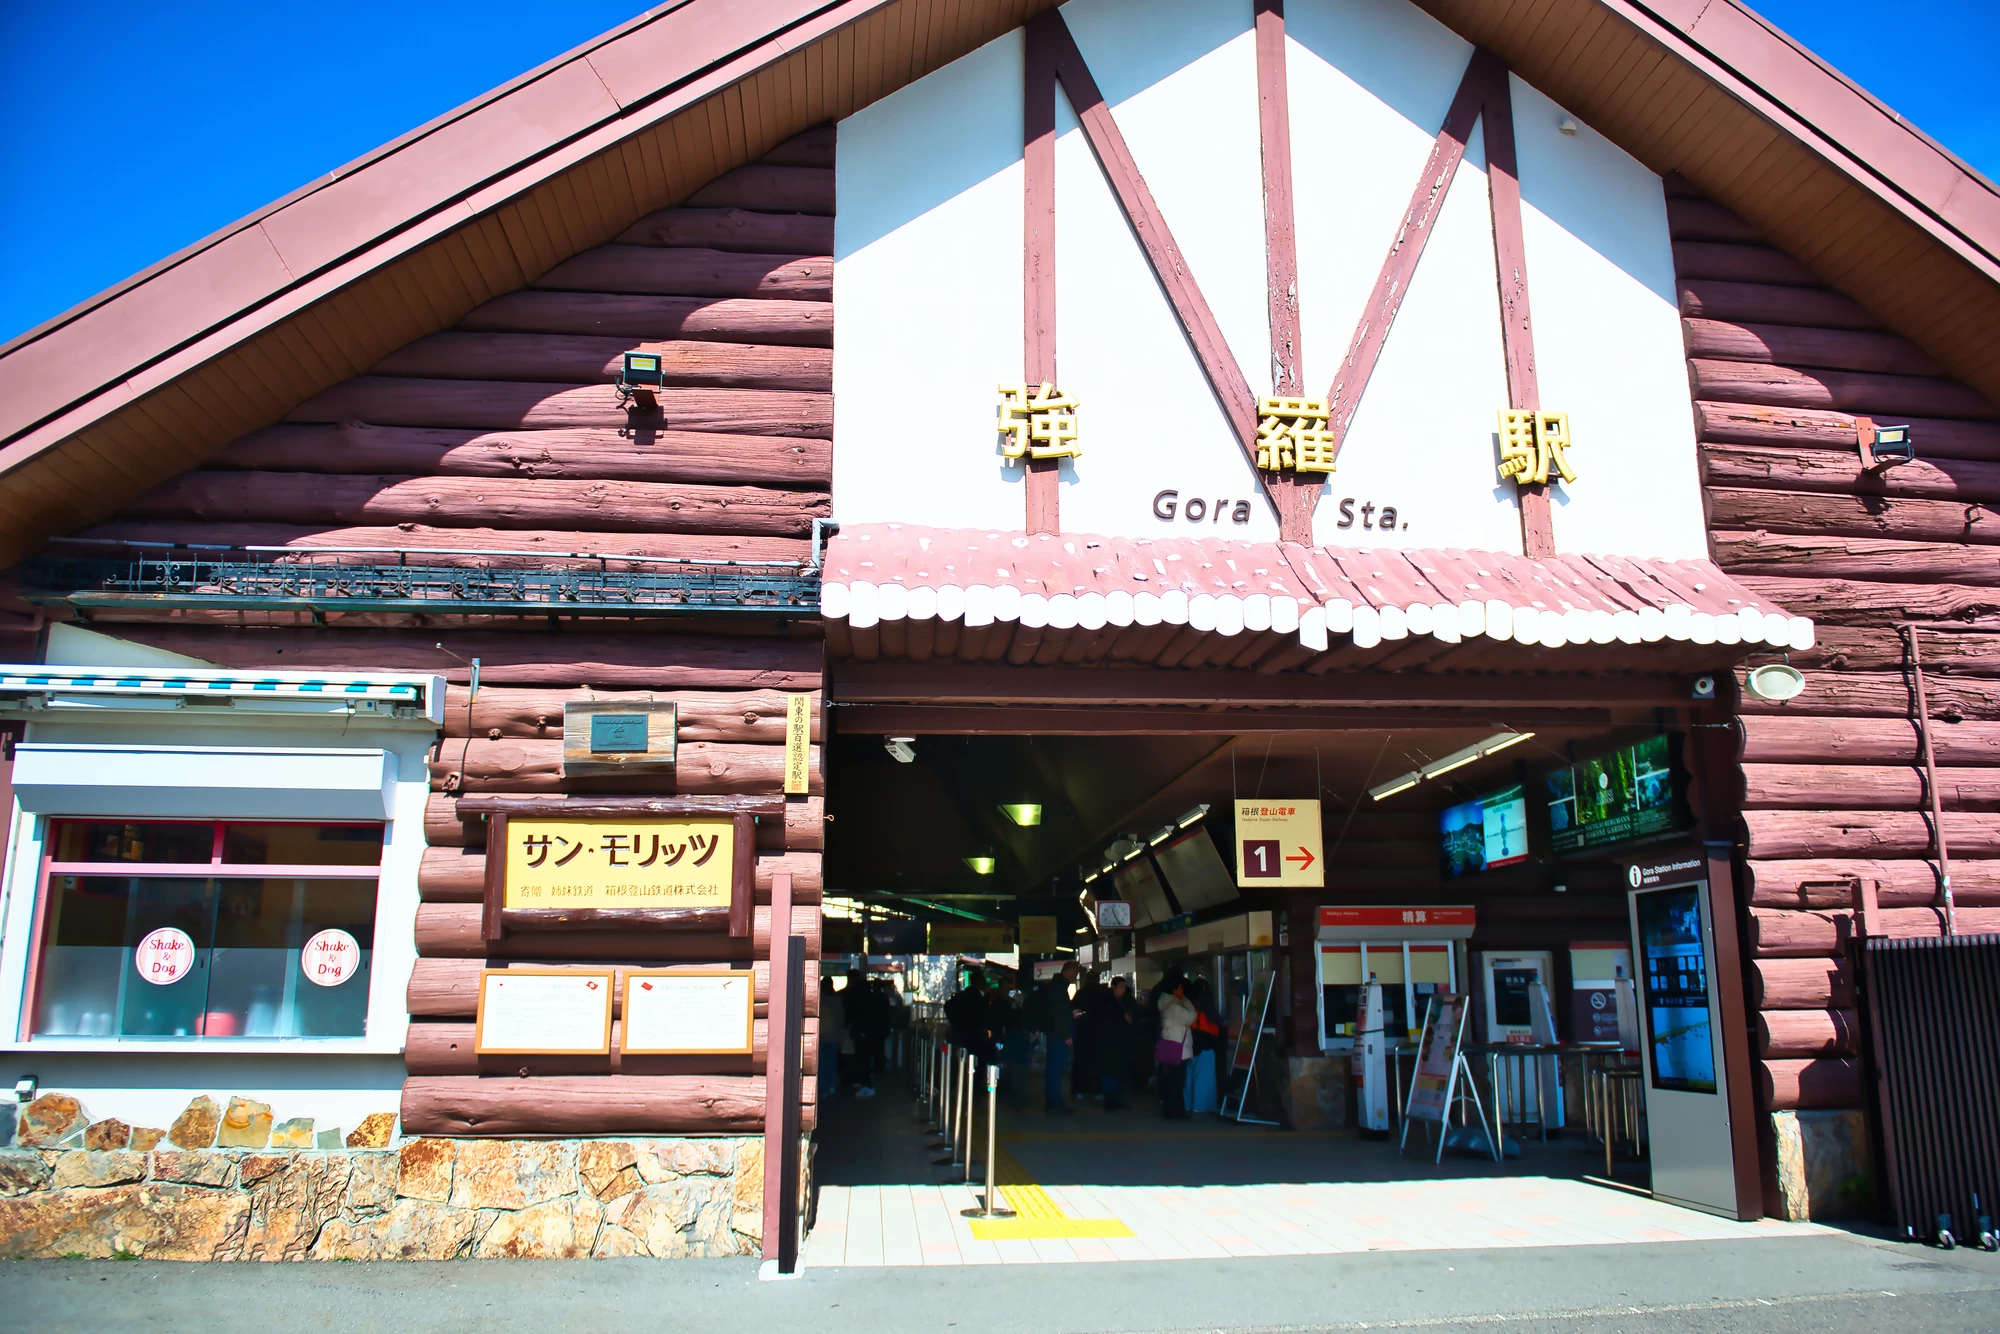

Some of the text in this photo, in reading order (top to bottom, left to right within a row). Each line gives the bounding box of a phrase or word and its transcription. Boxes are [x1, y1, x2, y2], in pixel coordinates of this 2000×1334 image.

[1152, 489, 1409, 530] Gora Sta.
[791, 696, 805, 780] 関東の駅百選認定駅
[1241, 807, 1296, 816] 箱根登山電車
[523, 834, 719, 868] サン・モリッツ
[1253, 846, 1267, 872] 1
[1642, 859, 1701, 876] Gora Station Information
[551, 885, 594, 897] 姉妹鉄道
[605, 884, 719, 896] 箱根登山鉄道株式会社
[1402, 910, 1427, 923] 精算
[149, 938, 186, 951] Shake
[315, 940, 350, 952] Shake
[162, 951, 171, 961] &
[328, 953, 336, 962] &
[152, 962, 178, 976] Dog
[318, 963, 342, 977] Dog
